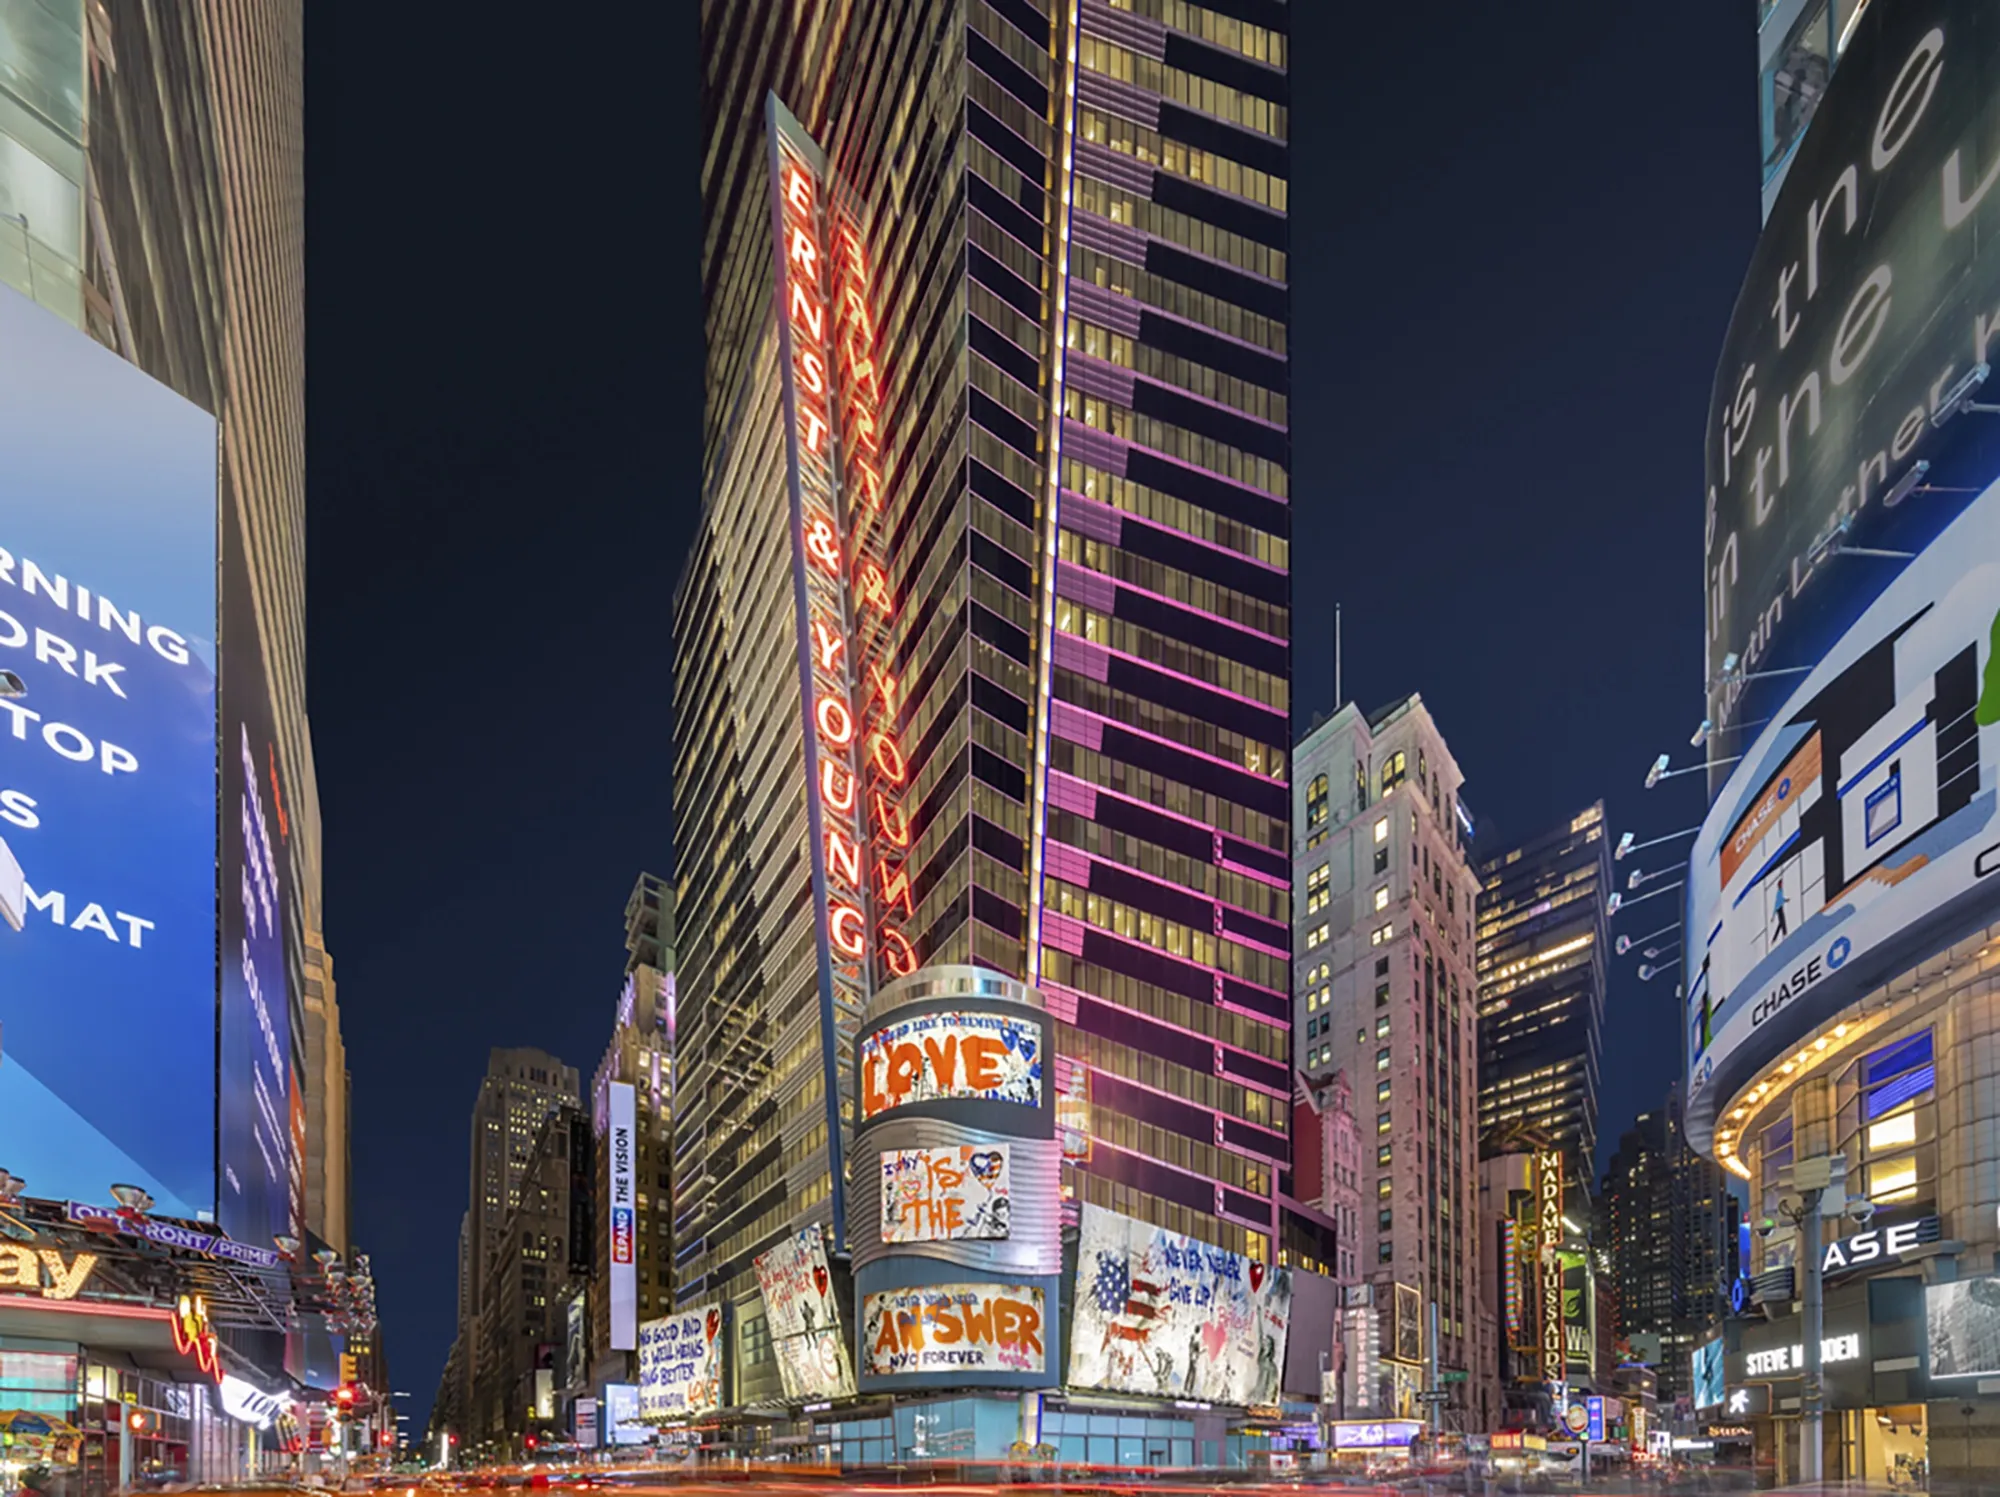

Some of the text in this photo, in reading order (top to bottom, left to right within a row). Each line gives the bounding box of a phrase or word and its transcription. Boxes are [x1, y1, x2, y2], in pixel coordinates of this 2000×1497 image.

[788, 168, 866, 957] ERNST & YOUNG
[1735, 793, 1777, 854] CHASE
[1751, 955, 1822, 1027] CHASE
[942, 1016, 957, 1027] TO
[863, 1034, 1010, 1119] LOVE
[616, 1127, 629, 1262] EXPAND THE VISION
[902, 1197, 965, 1239] THE
[1540, 1151, 1558, 1243] MADAME
[219, 1242, 271, 1266] PRIME
[1165, 1240, 1204, 1272] NEVER
[873, 1297, 1043, 1356] ANSWER
[889, 1351, 919, 1368] NYC
[922, 1350, 985, 1365] FOREVER
[1746, 1346, 1789, 1376] STEVE
